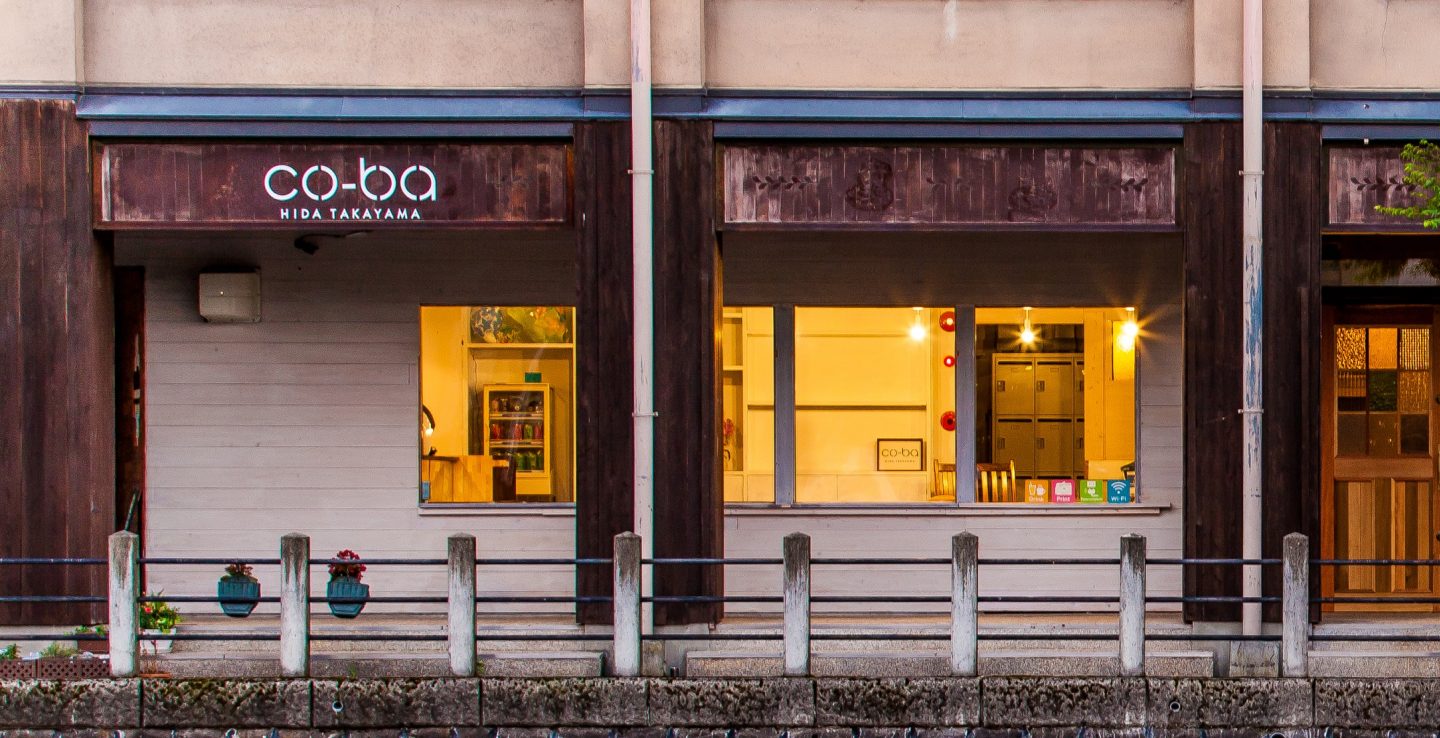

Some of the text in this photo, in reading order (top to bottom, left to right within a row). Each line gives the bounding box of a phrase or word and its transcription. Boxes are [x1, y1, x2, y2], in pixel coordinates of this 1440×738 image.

[264, 157, 437, 201] co-ba
[280, 208, 421, 219] HIDA TAKAYAMA
